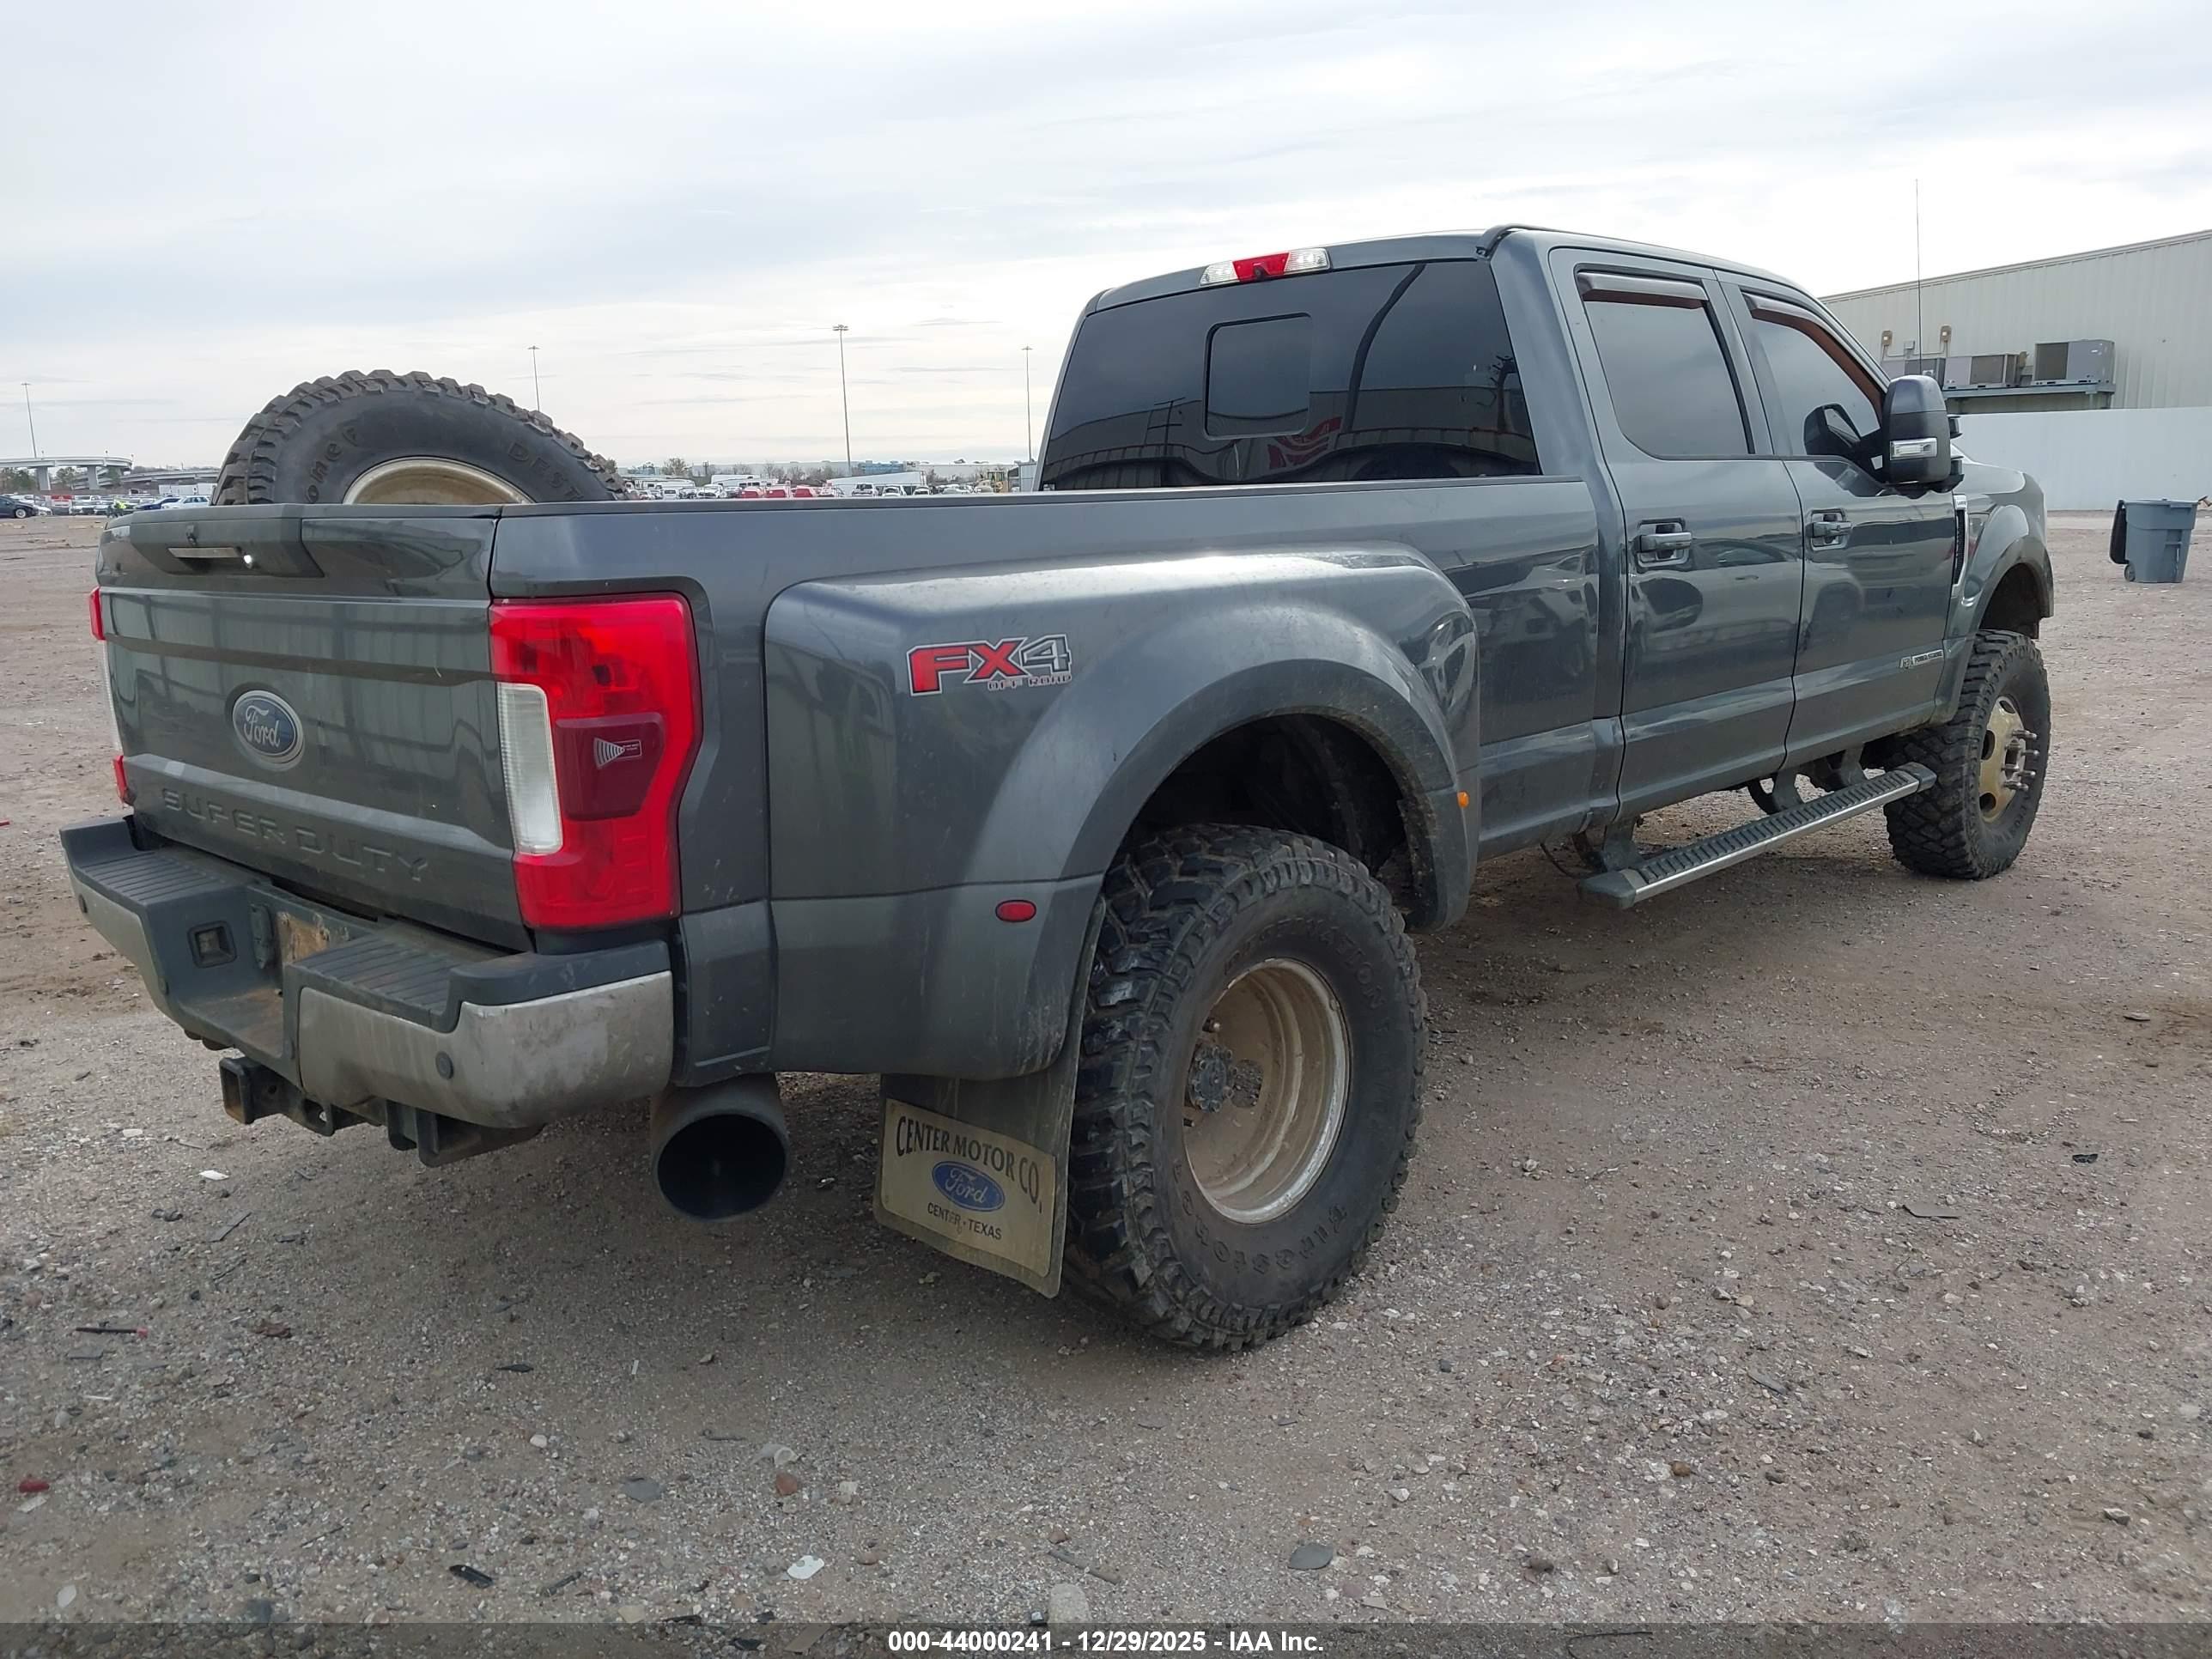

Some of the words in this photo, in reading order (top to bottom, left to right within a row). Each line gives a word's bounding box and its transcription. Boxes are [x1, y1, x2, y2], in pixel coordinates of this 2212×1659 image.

[907, 634, 1073, 696] FX4
[244, 705, 281, 748] Ford
[162, 788, 288, 844] SUPER
[296, 827, 428, 882] DUTY
[896, 1115, 951, 1157] CENTER
[953, 1134, 1015, 1181] MOTOR
[945, 1168, 989, 1204] Ford
[927, 1201, 962, 1226] CENTER
[969, 1218, 1002, 1241] TEXAS
